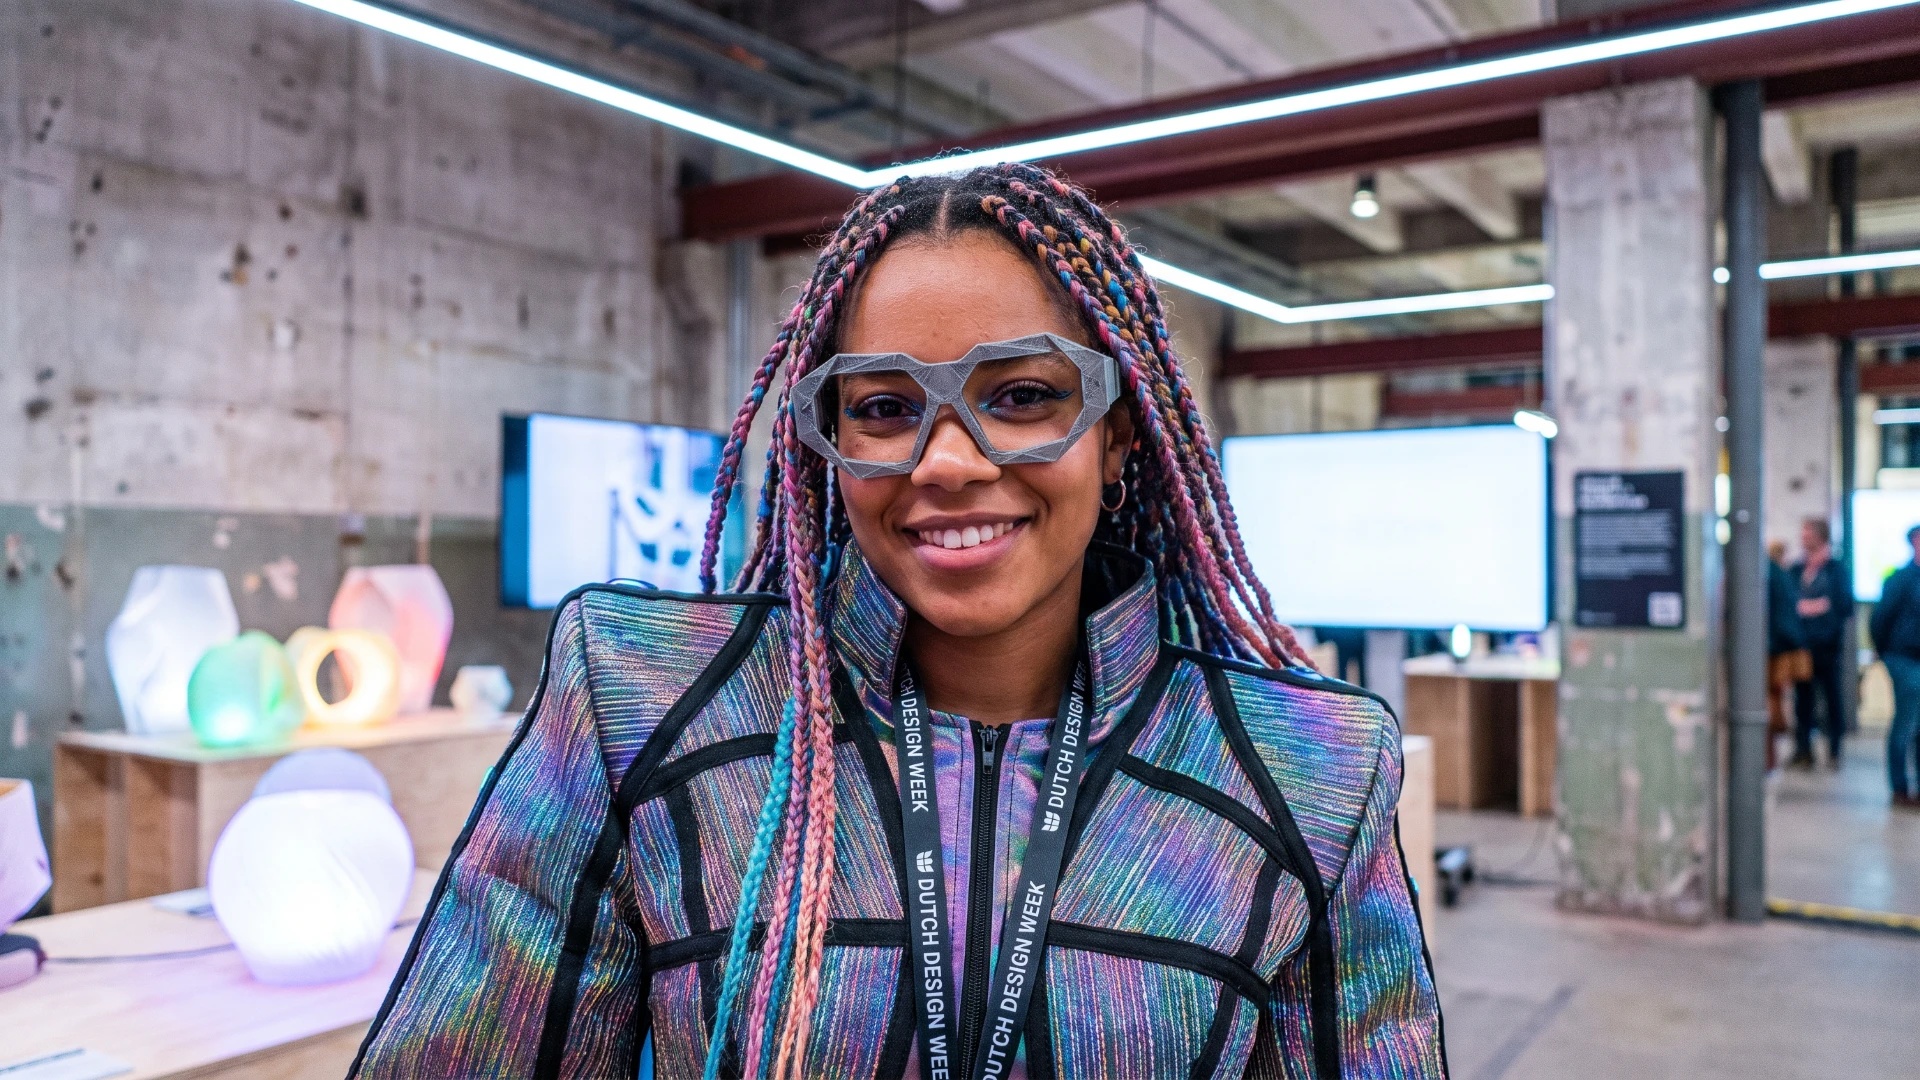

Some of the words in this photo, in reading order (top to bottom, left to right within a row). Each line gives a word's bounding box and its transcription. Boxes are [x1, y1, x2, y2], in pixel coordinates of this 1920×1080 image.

[900, 663, 915, 697] TCH
[901, 698, 923, 757] DESIGN
[1047, 749, 1075, 809] DUTCH
[1064, 691, 1084, 747] DESIGN
[908, 762, 929, 813] WEEK
[918, 879, 939, 946] DUTCH
[1000, 938, 1033, 1013] DESIGN
[1018, 880, 1046, 934] WEEK
[923, 952, 945, 1029] DESIGN
[929, 1035, 949, 1080] WEE
